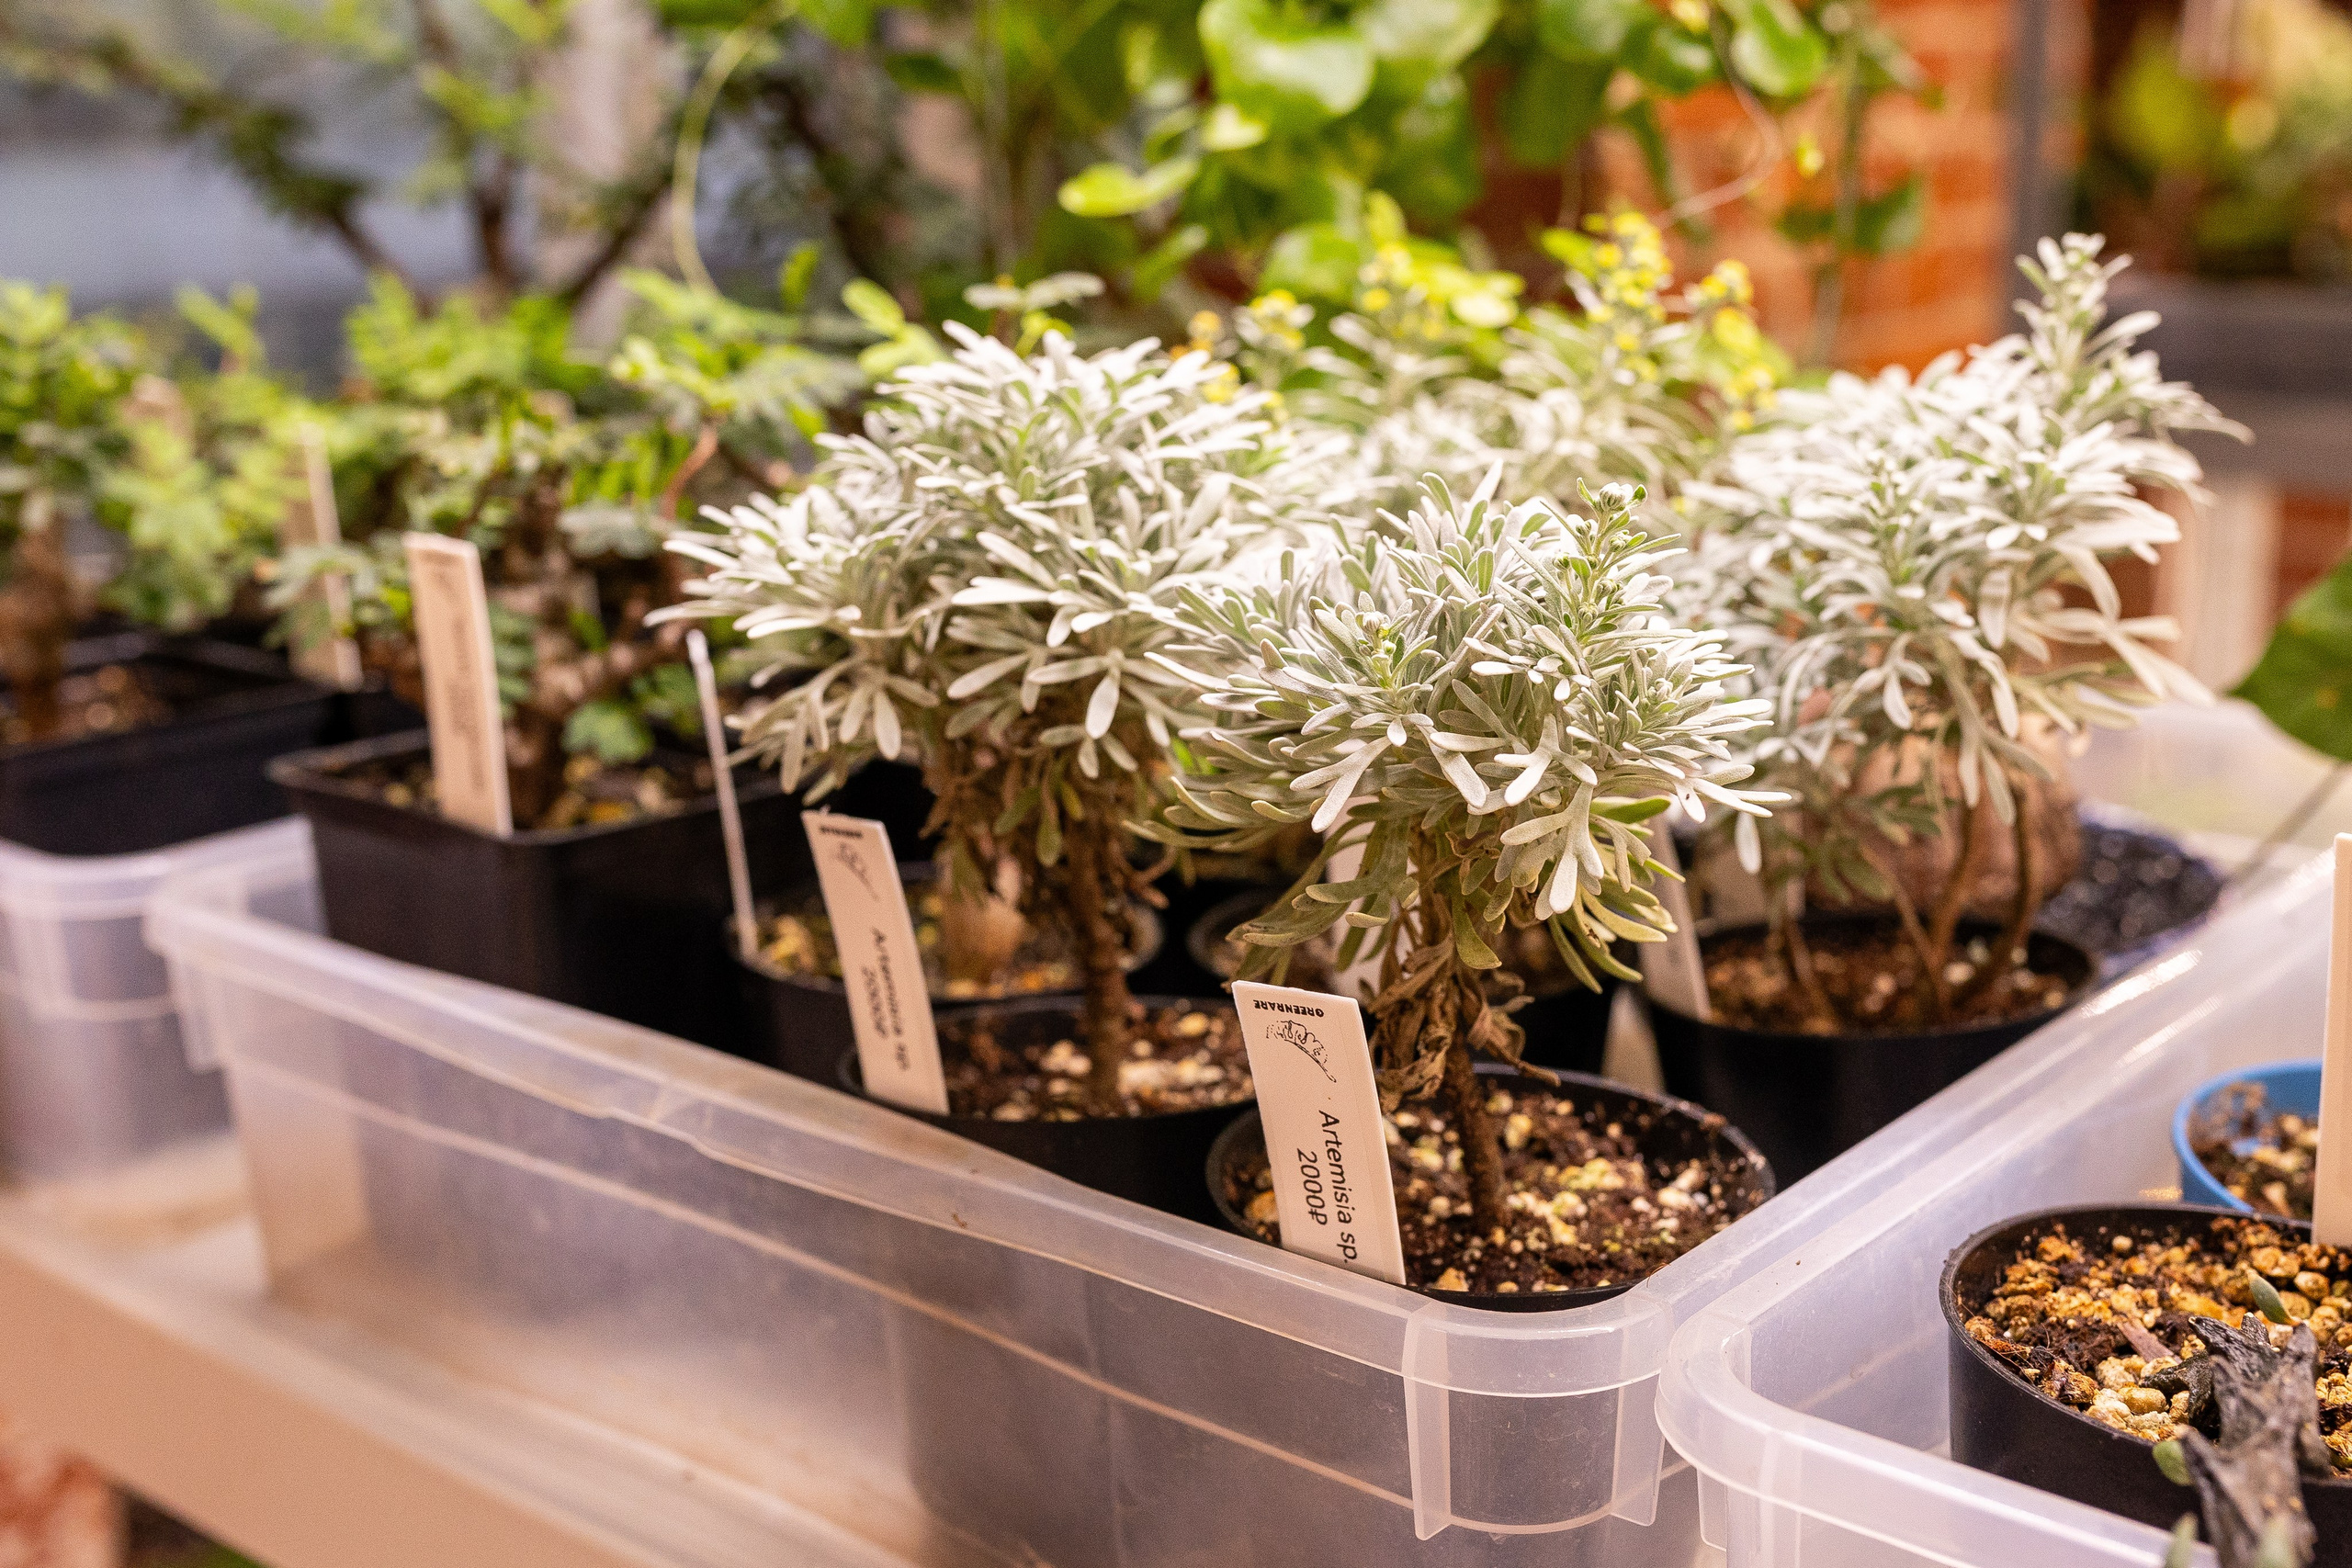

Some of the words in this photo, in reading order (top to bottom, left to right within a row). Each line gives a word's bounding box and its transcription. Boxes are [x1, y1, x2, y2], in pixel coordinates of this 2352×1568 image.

[1253, 999, 1324, 1018] GREENRARE
[1318, 1109, 1354, 1224] Artemisia
[1337, 1233, 1358, 1263] sp.
